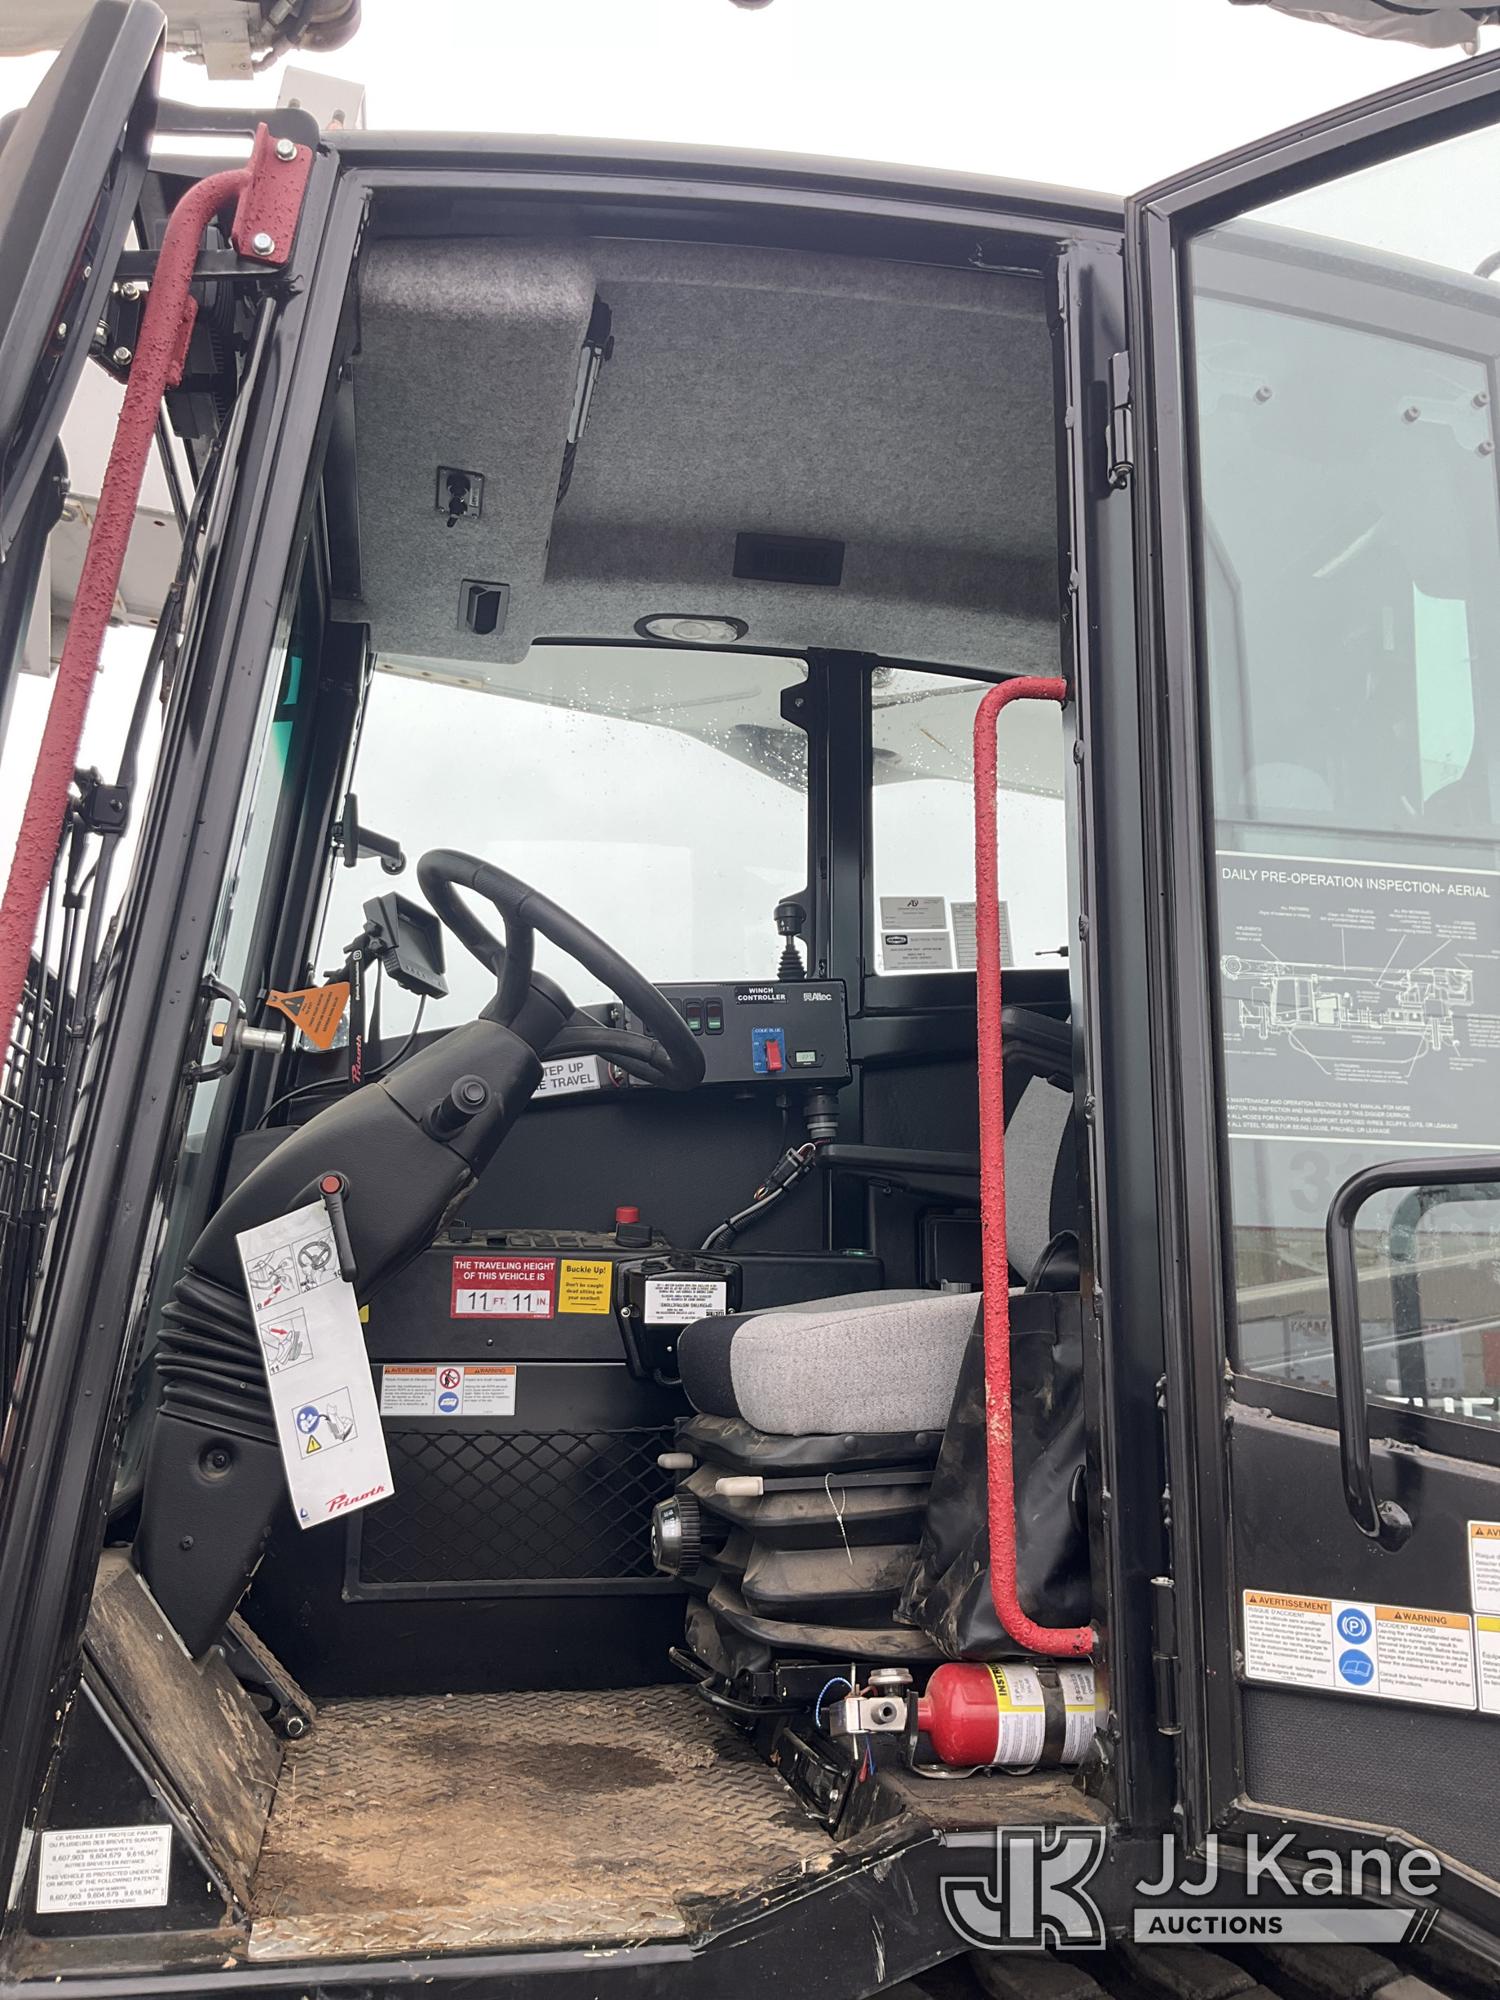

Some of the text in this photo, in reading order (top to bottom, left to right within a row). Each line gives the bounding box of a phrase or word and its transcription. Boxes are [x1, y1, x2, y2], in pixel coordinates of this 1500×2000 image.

[1222, 868, 1258, 881] DAILY
[1261, 870, 1363, 888] PRE-OPERATION
[1447, 884, 1490, 898] AERIAL
[544, 1063, 583, 1076] TEP UP
[551, 1074, 594, 1088] TRAVEL
[475, 1262, 521, 1270] TRAVELING
[523, 1262, 555, 1270] HEIGHT
[594, 1266, 606, 1274] Up!
[468, 1292, 487, 1310] 11
[494, 1297, 505, 1305] FT.
[513, 1293, 531, 1312] 11
[270, 1365, 280, 1373] 11
[325, 1485, 385, 1512] Prinoth
[1259, 1597, 1328, 1610] AVERTISSEMENT
[1403, 1614, 1447, 1624] WARNING
[1410, 1625, 1436, 1633] HAZARD
